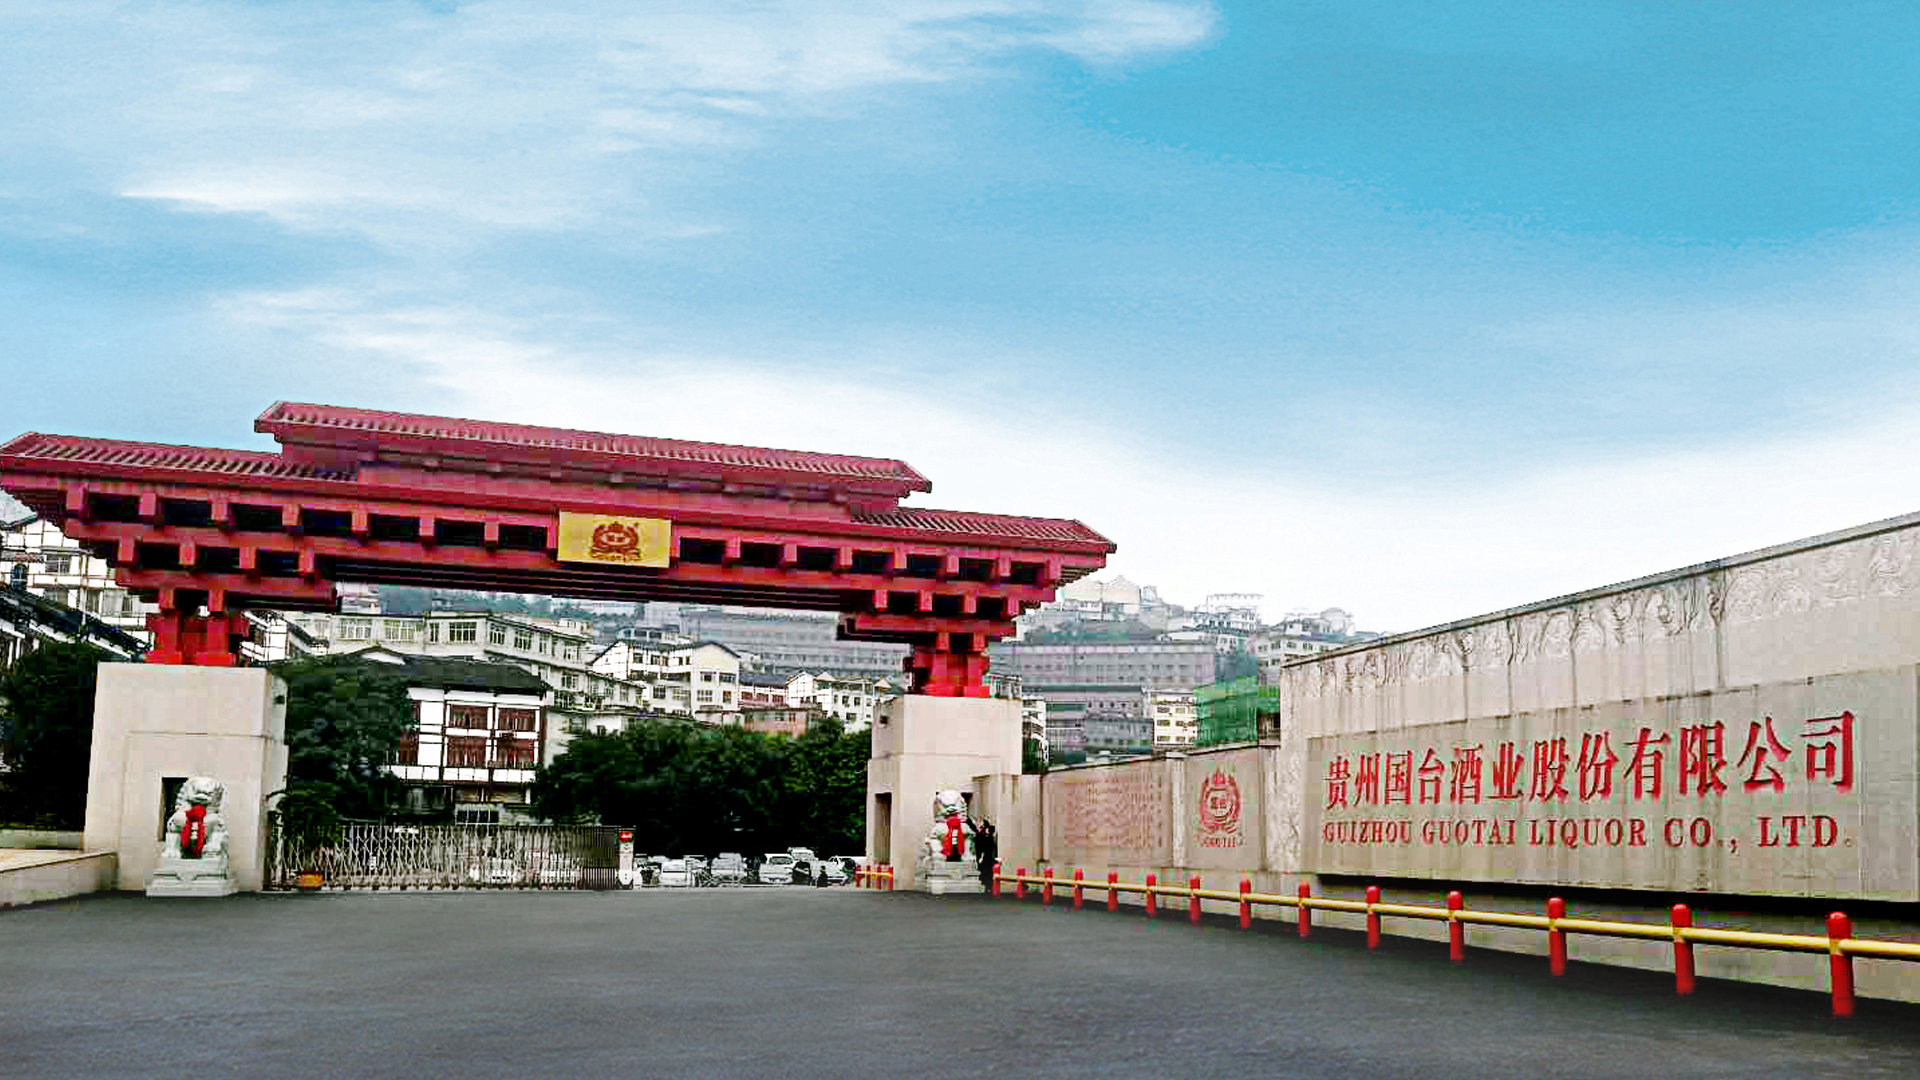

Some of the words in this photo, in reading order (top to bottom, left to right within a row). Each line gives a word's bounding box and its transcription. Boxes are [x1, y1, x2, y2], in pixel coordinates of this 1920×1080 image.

[1323, 709, 1855, 810] 贵州国台酒业股份有限公司
[1324, 820, 1411, 845] GUIZHOU
[1422, 819, 1515, 845] GUOTAI
[1528, 818, 1647, 848] LIQUOR
